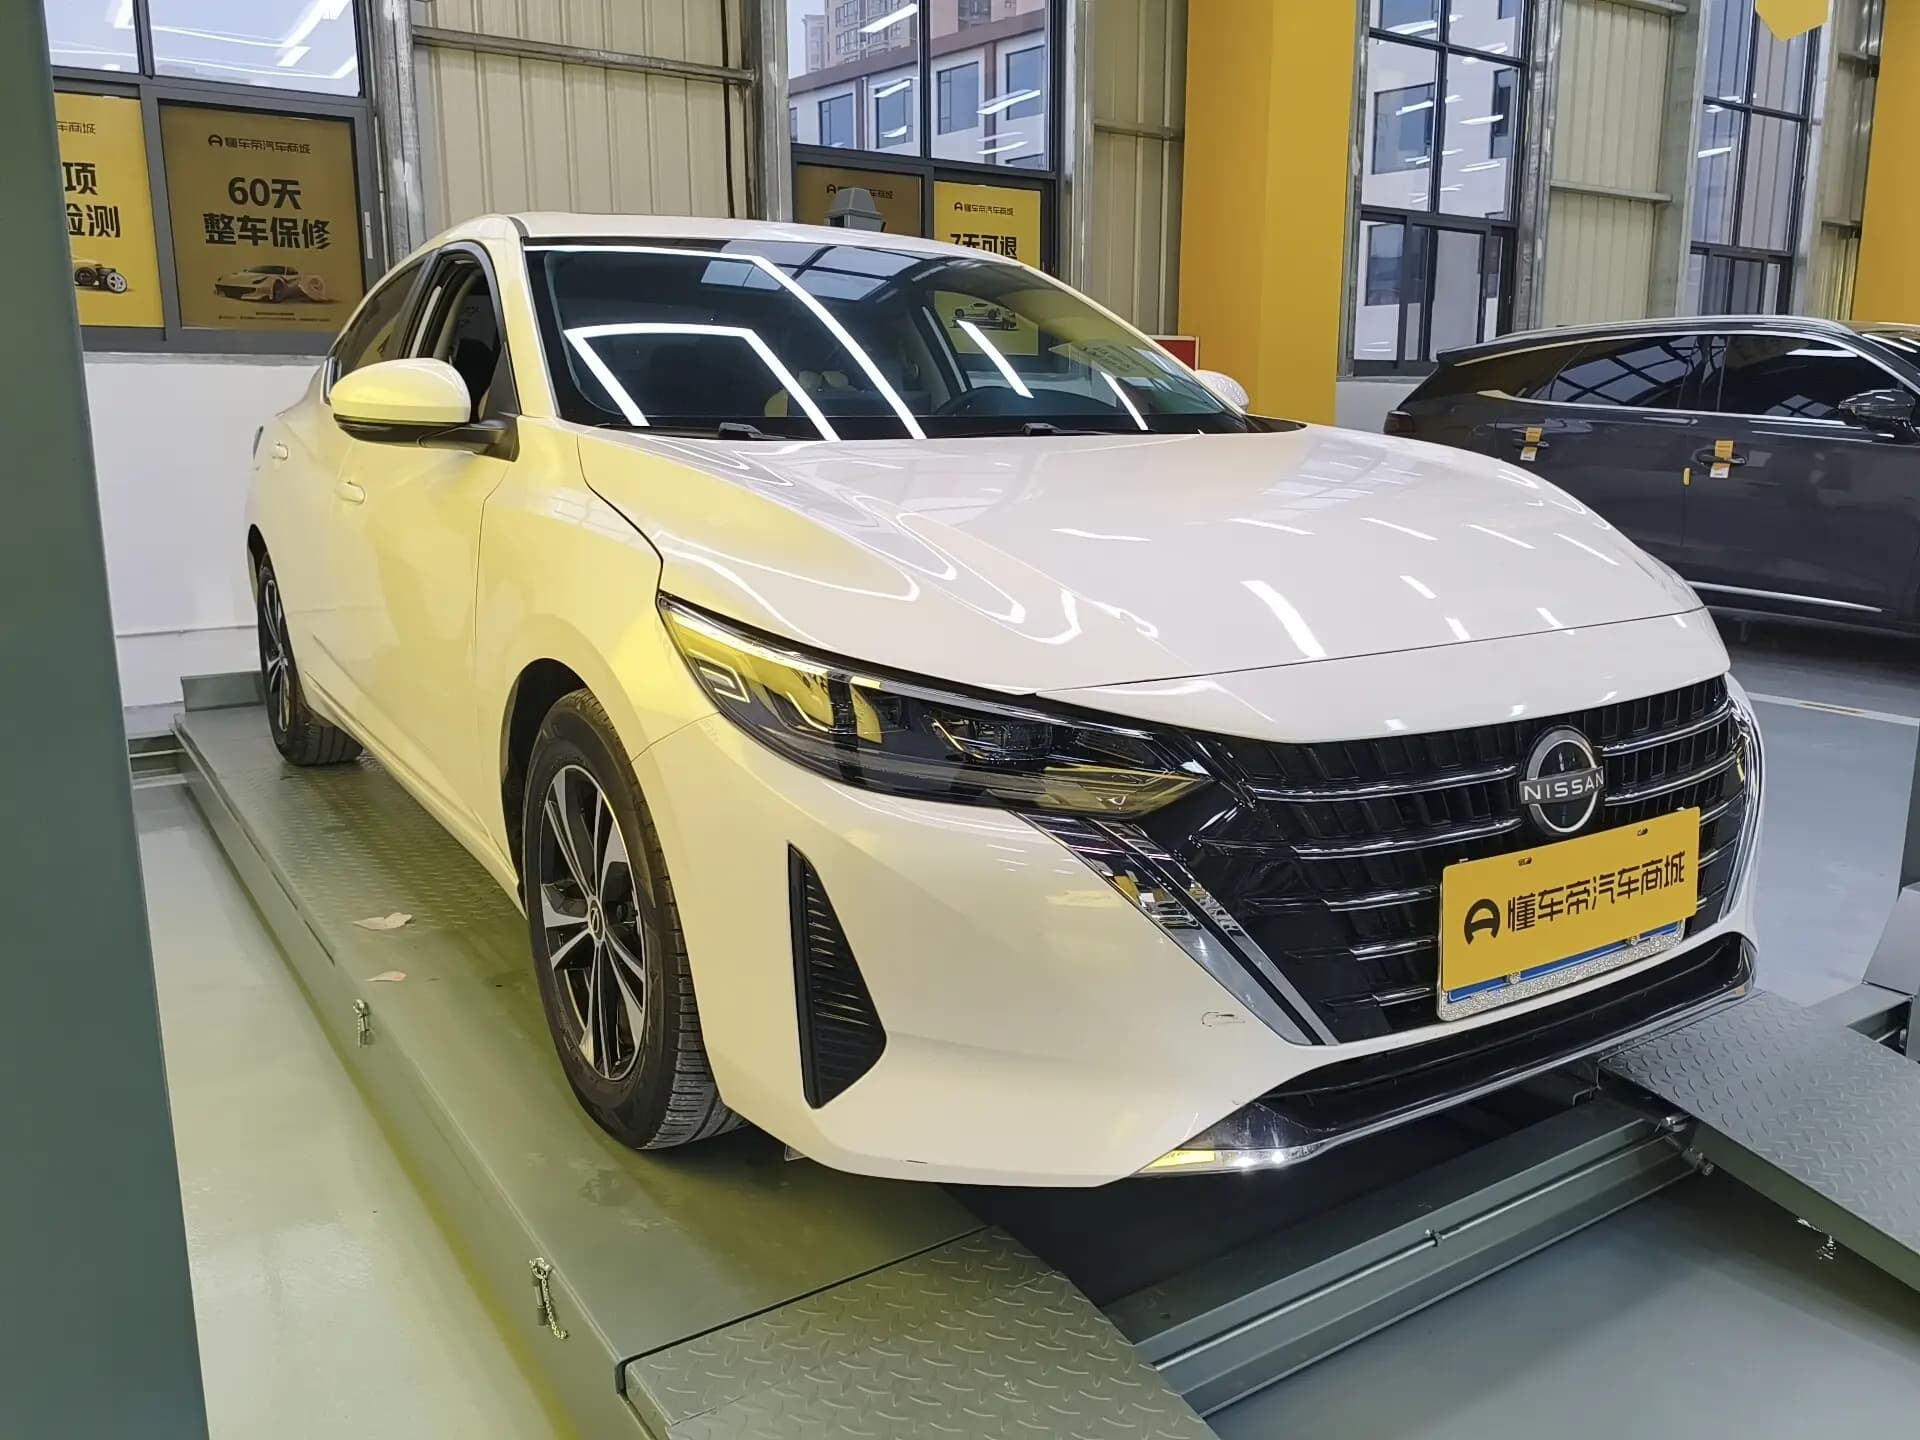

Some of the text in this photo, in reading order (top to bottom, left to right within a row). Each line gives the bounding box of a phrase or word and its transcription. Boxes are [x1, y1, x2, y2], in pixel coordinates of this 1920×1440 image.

[62, 162, 98, 195] 项
[228, 177, 302, 209] 60天
[203, 212, 332, 249] 整车保修
[1523, 772, 1605, 801] NISSAN
[1507, 850, 1687, 932] 懂车帝汽车商城
